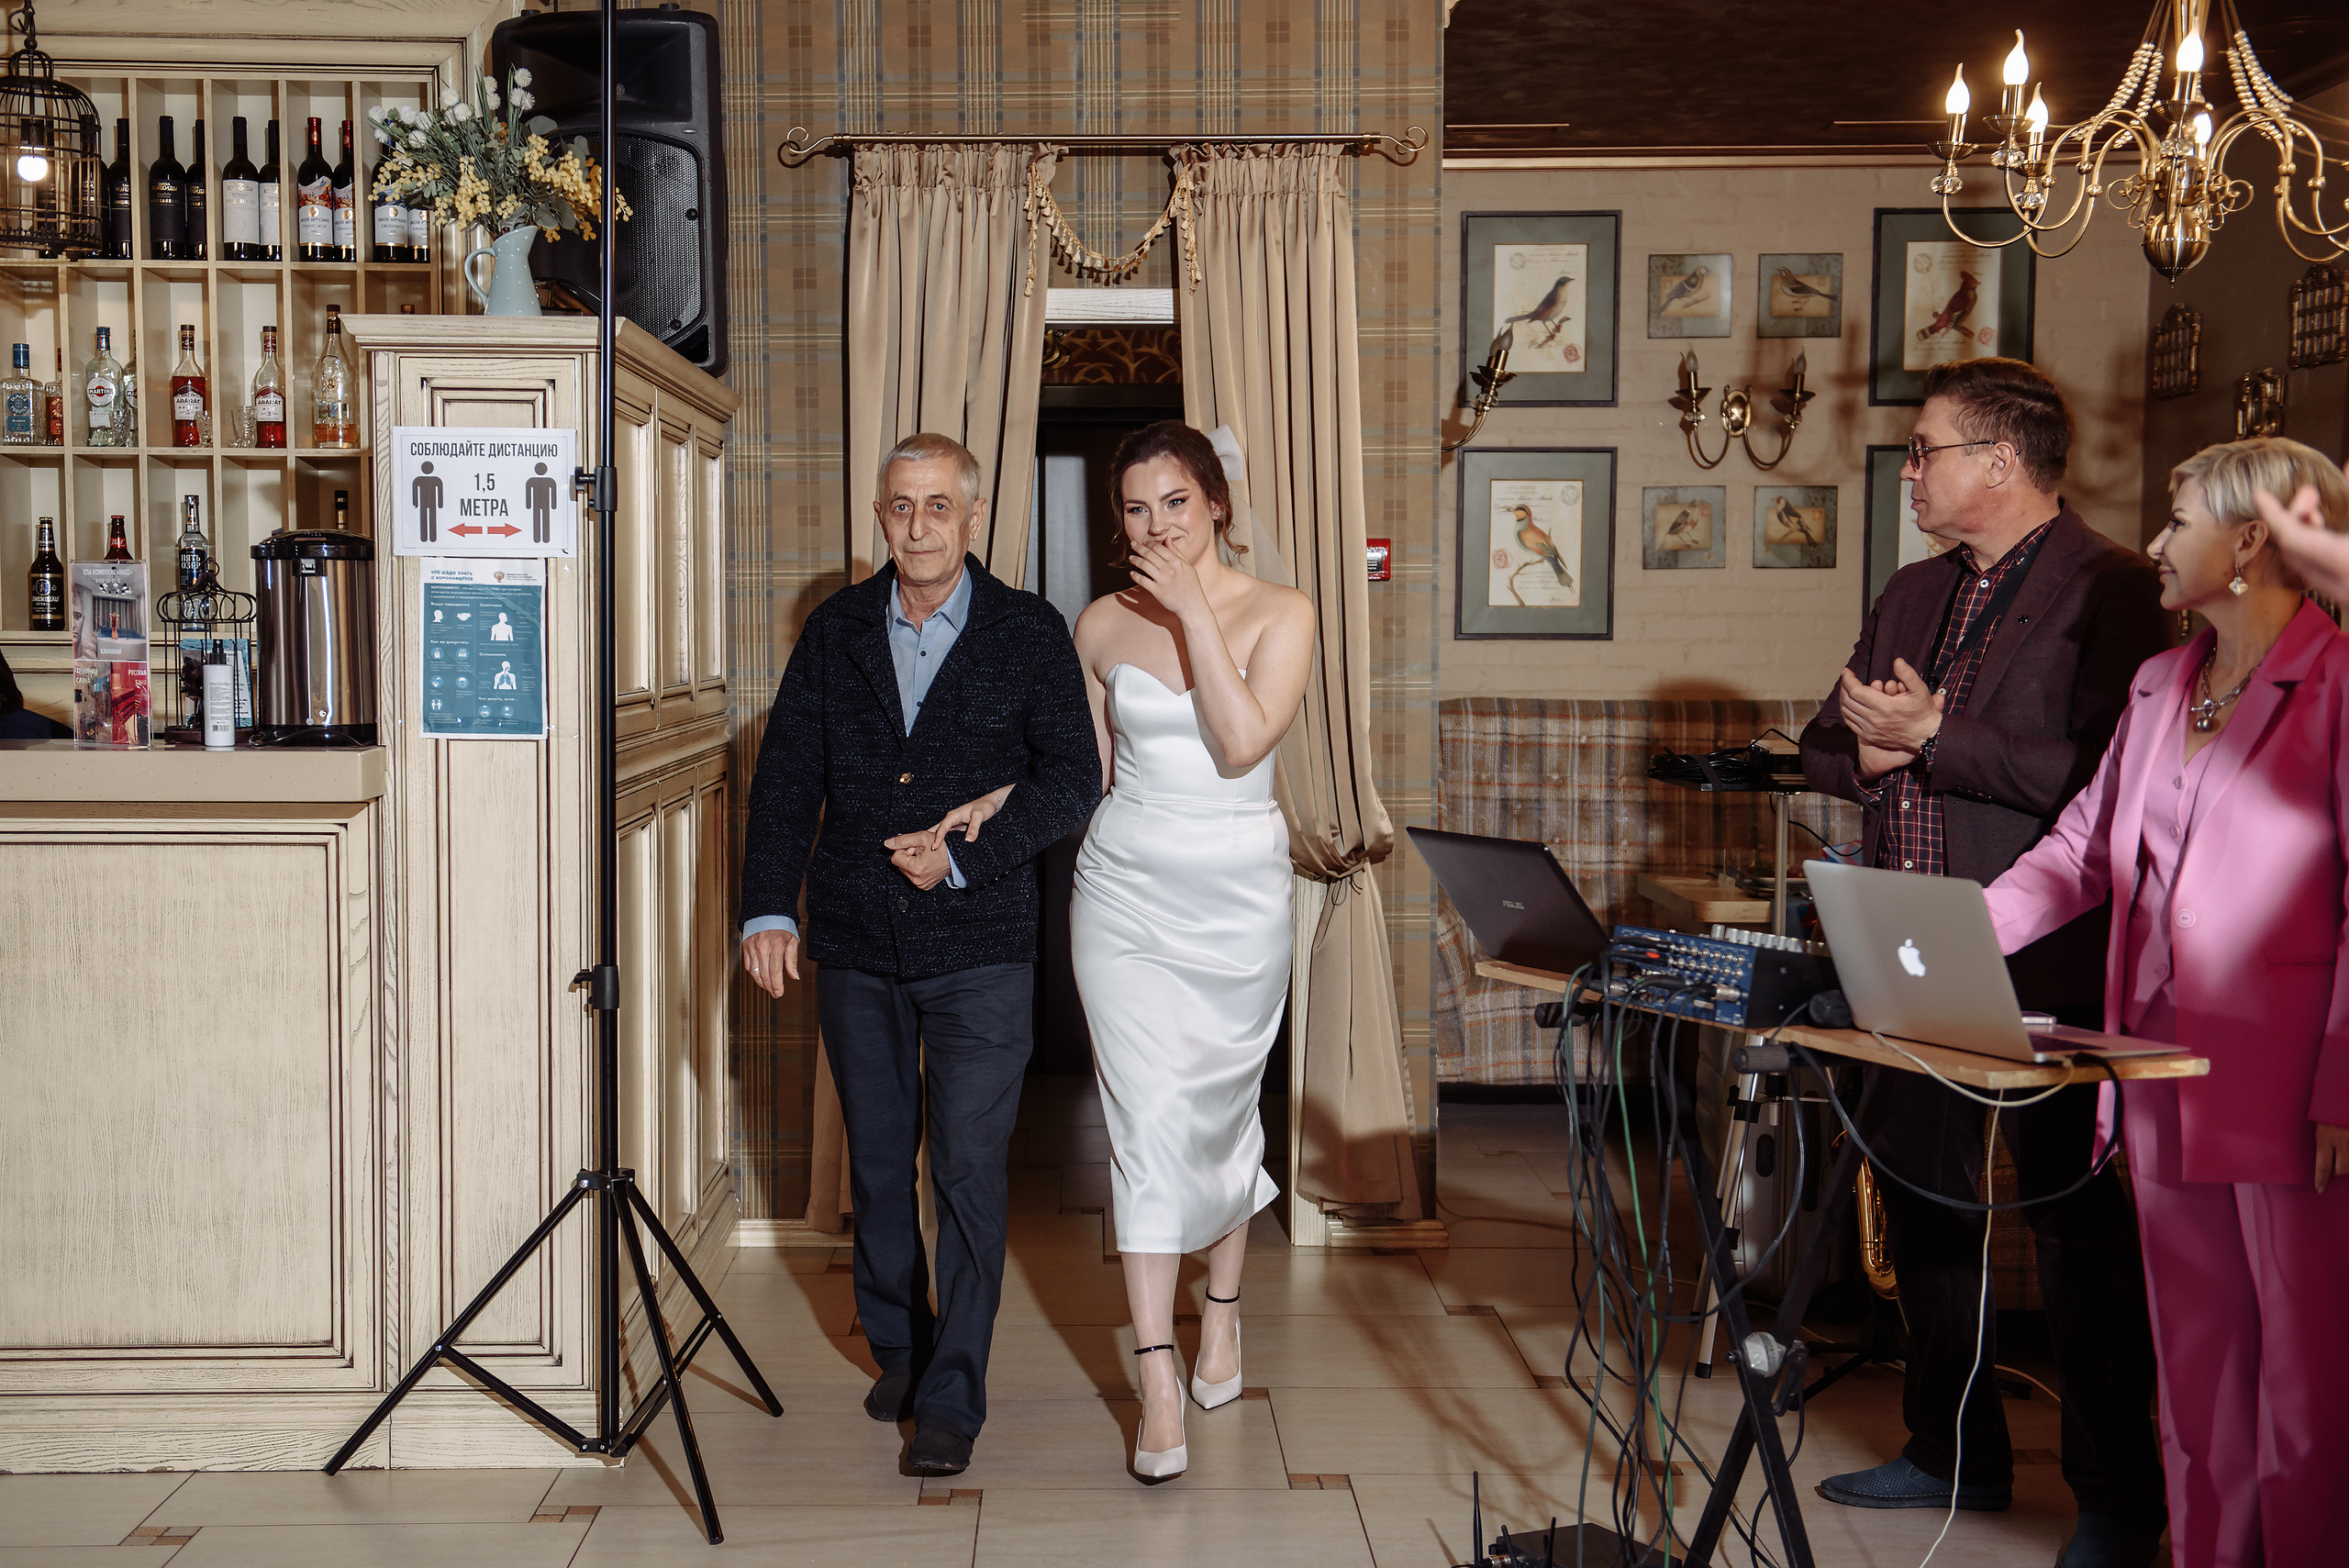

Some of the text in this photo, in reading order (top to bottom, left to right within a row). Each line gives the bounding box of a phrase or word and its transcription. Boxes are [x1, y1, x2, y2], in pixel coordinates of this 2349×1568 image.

[410, 440, 558, 459] СОБЛЮДАЙТЕ ДИСТАНЦИЮ
[473, 473, 495, 493] 1,5
[460, 498, 508, 517] МЕТРА
[1502, 899, 1525, 910] ASUS
